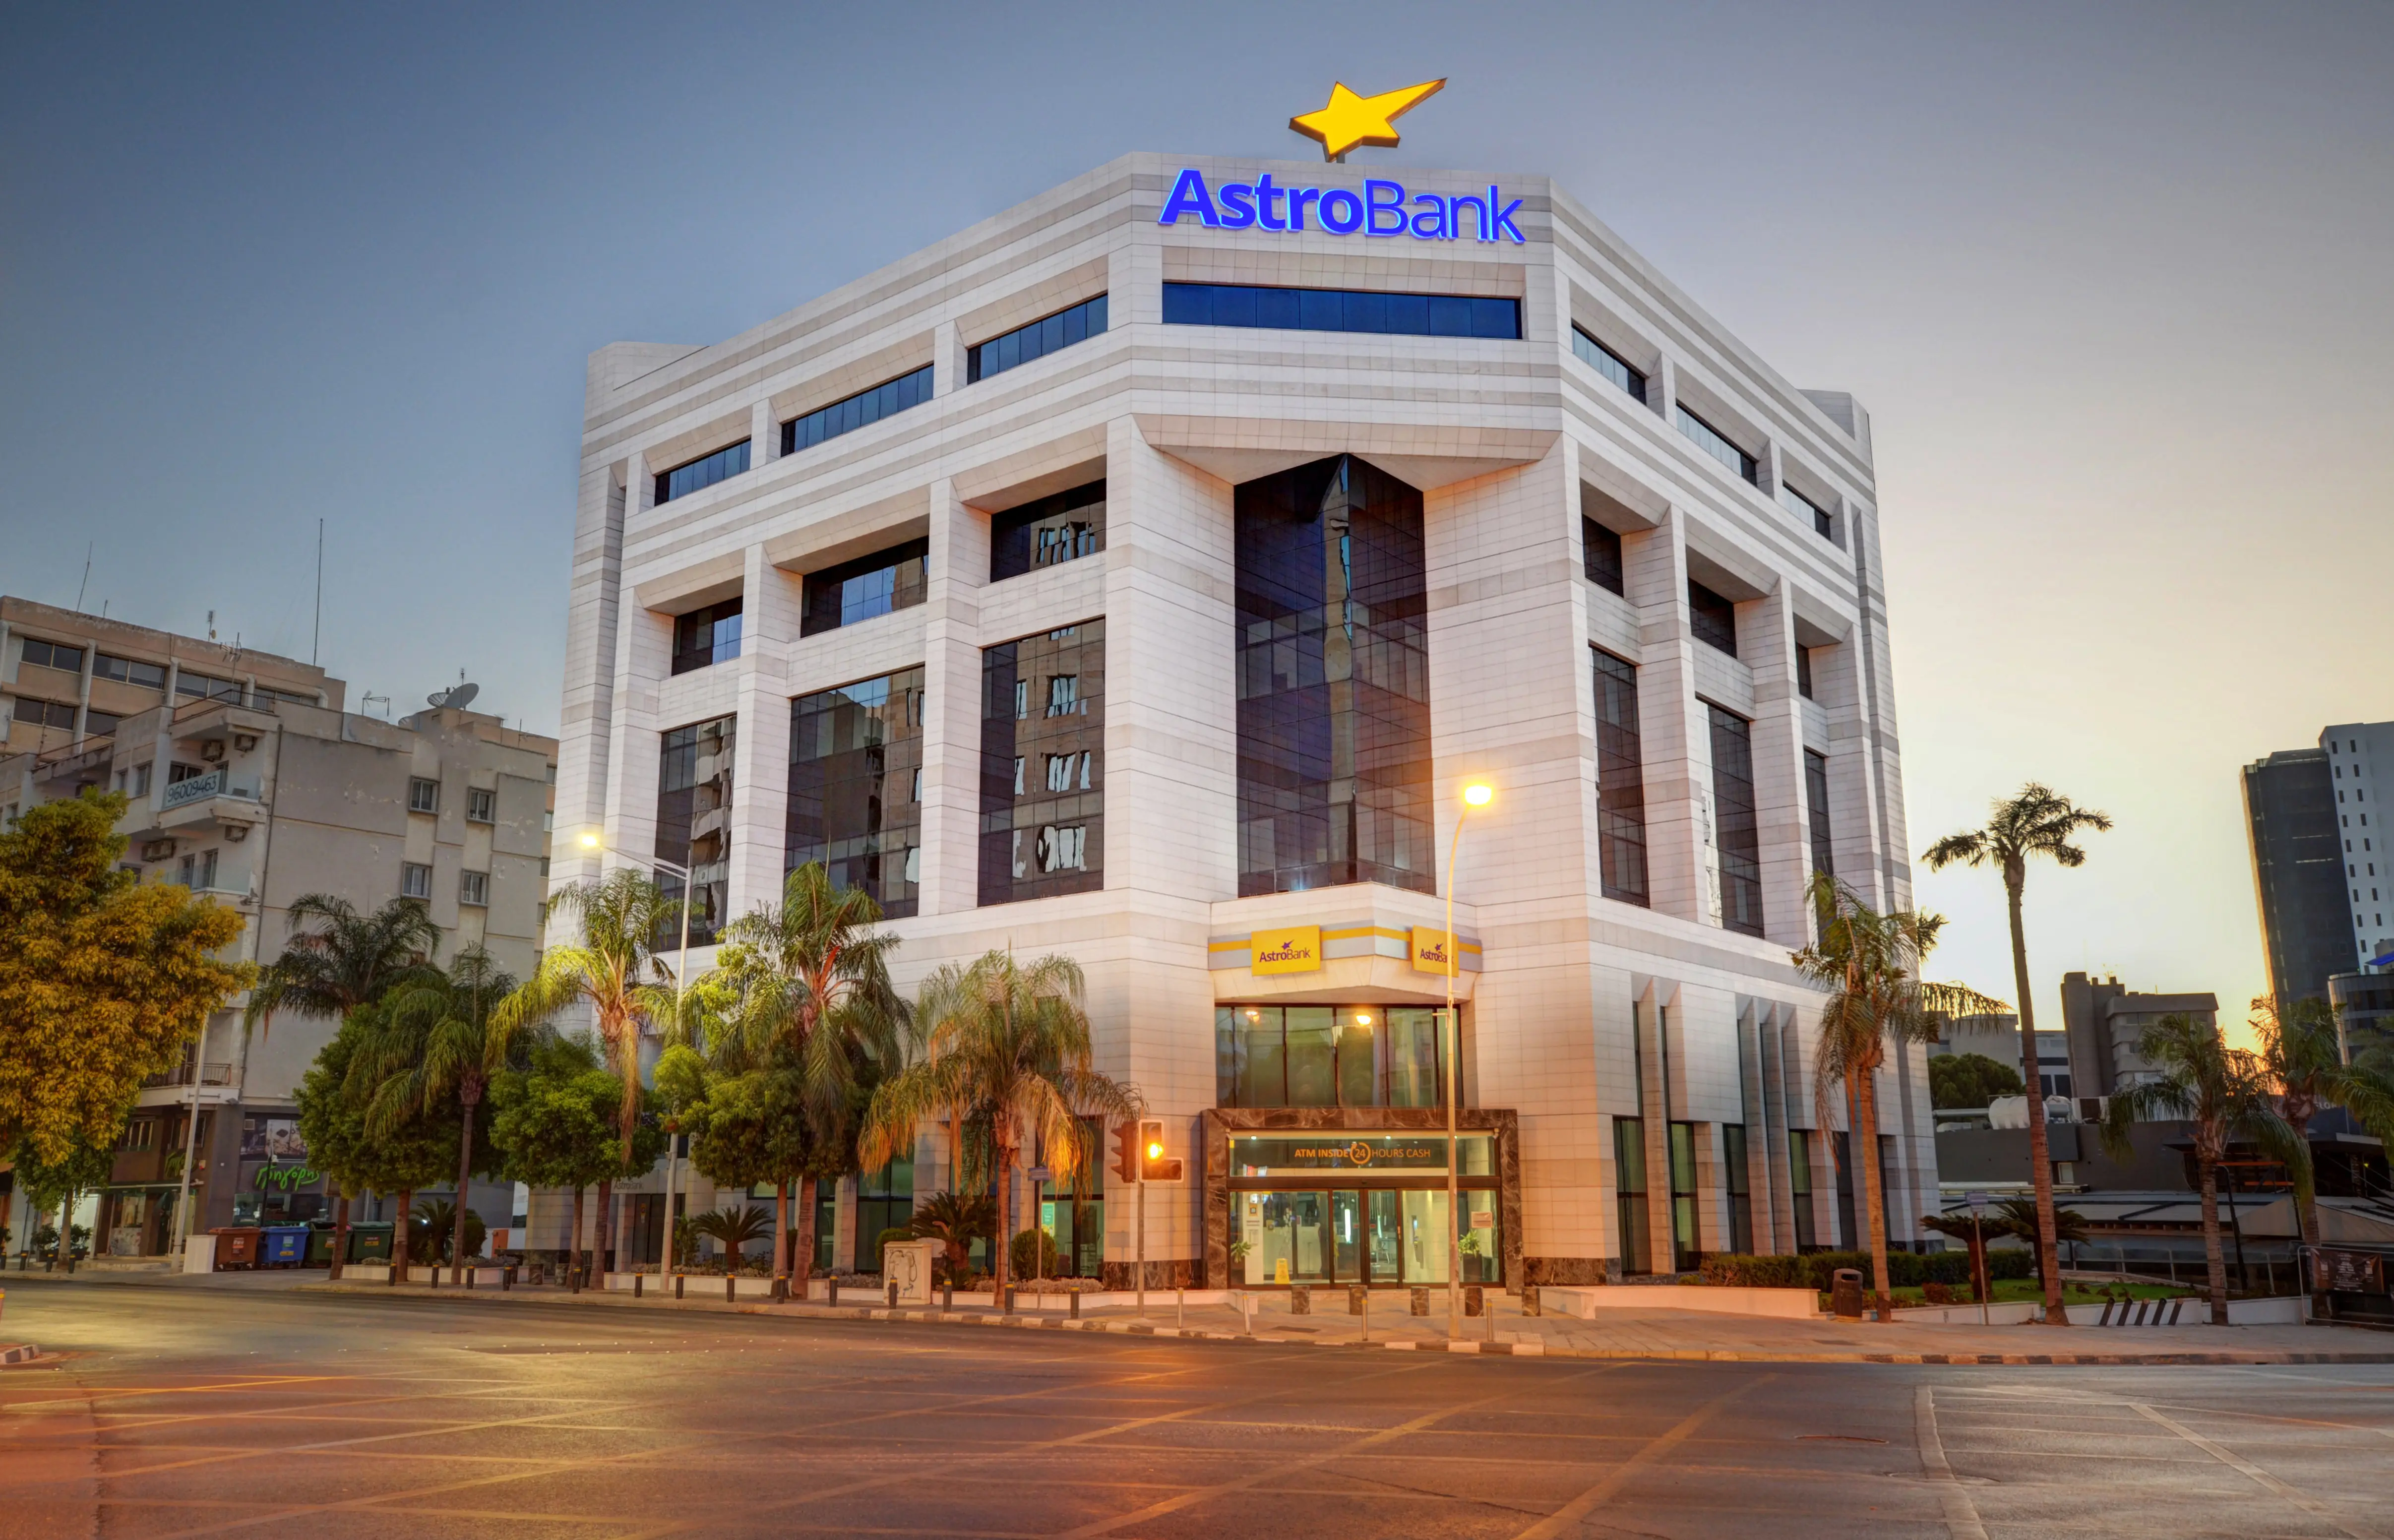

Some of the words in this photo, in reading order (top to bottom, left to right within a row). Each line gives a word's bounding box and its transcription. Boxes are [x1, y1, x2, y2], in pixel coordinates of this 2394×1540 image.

[1158, 169, 1526, 245] AstroBank
[168, 775, 217, 802] 96009463
[1259, 947, 1311, 962] AstroBank
[1420, 948, 1454, 964] AstroBa
[1294, 1149, 1315, 1158] ATM
[1318, 1149, 1349, 1158] INSIDE
[1354, 1148, 1366, 1158] 24
[1371, 1148, 1404, 1158] HOURS
[1406, 1148, 1431, 1158] CASH
